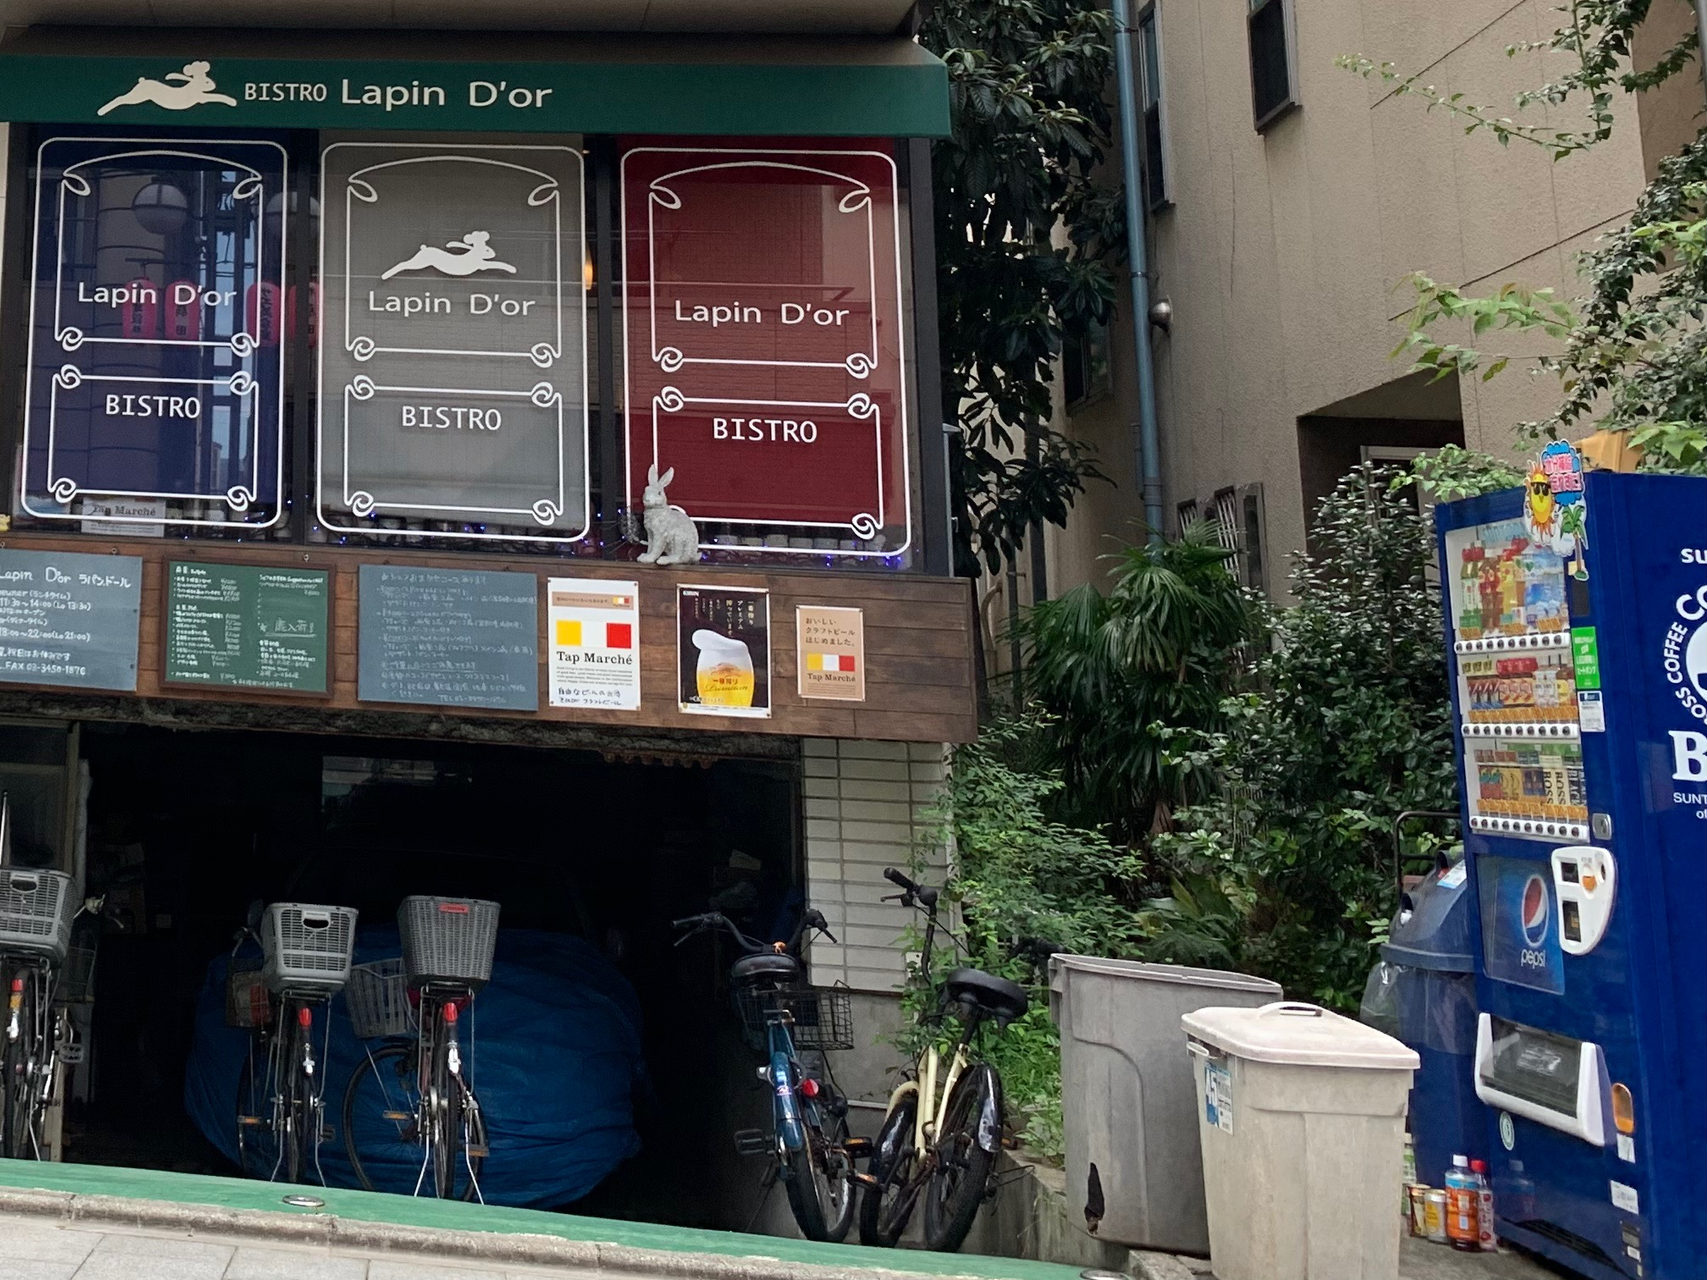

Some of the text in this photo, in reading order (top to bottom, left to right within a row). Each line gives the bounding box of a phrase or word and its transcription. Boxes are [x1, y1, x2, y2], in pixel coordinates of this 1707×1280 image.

[244, 78, 552, 111] BISTRO Lapin D'or
[77, 282, 238, 308] Lapin D'or
[368, 290, 536, 317] Lapin D'or
[675, 299, 850, 327] Lapin D'or
[105, 394, 201, 419] BISTRO
[401, 406, 502, 432] BISTRO
[712, 417, 818, 443] BISTRO
[805, 617, 837, 626] おいしい
[805, 627, 856, 637] クラフトビール
[556, 651, 633, 665] Tap Marché
[1663, 621, 1688, 684] COFFEE
[807, 673, 823, 683] Tap
[1543, 771, 1554, 805] BOSS
[1520, 948, 1547, 970] pepsi
